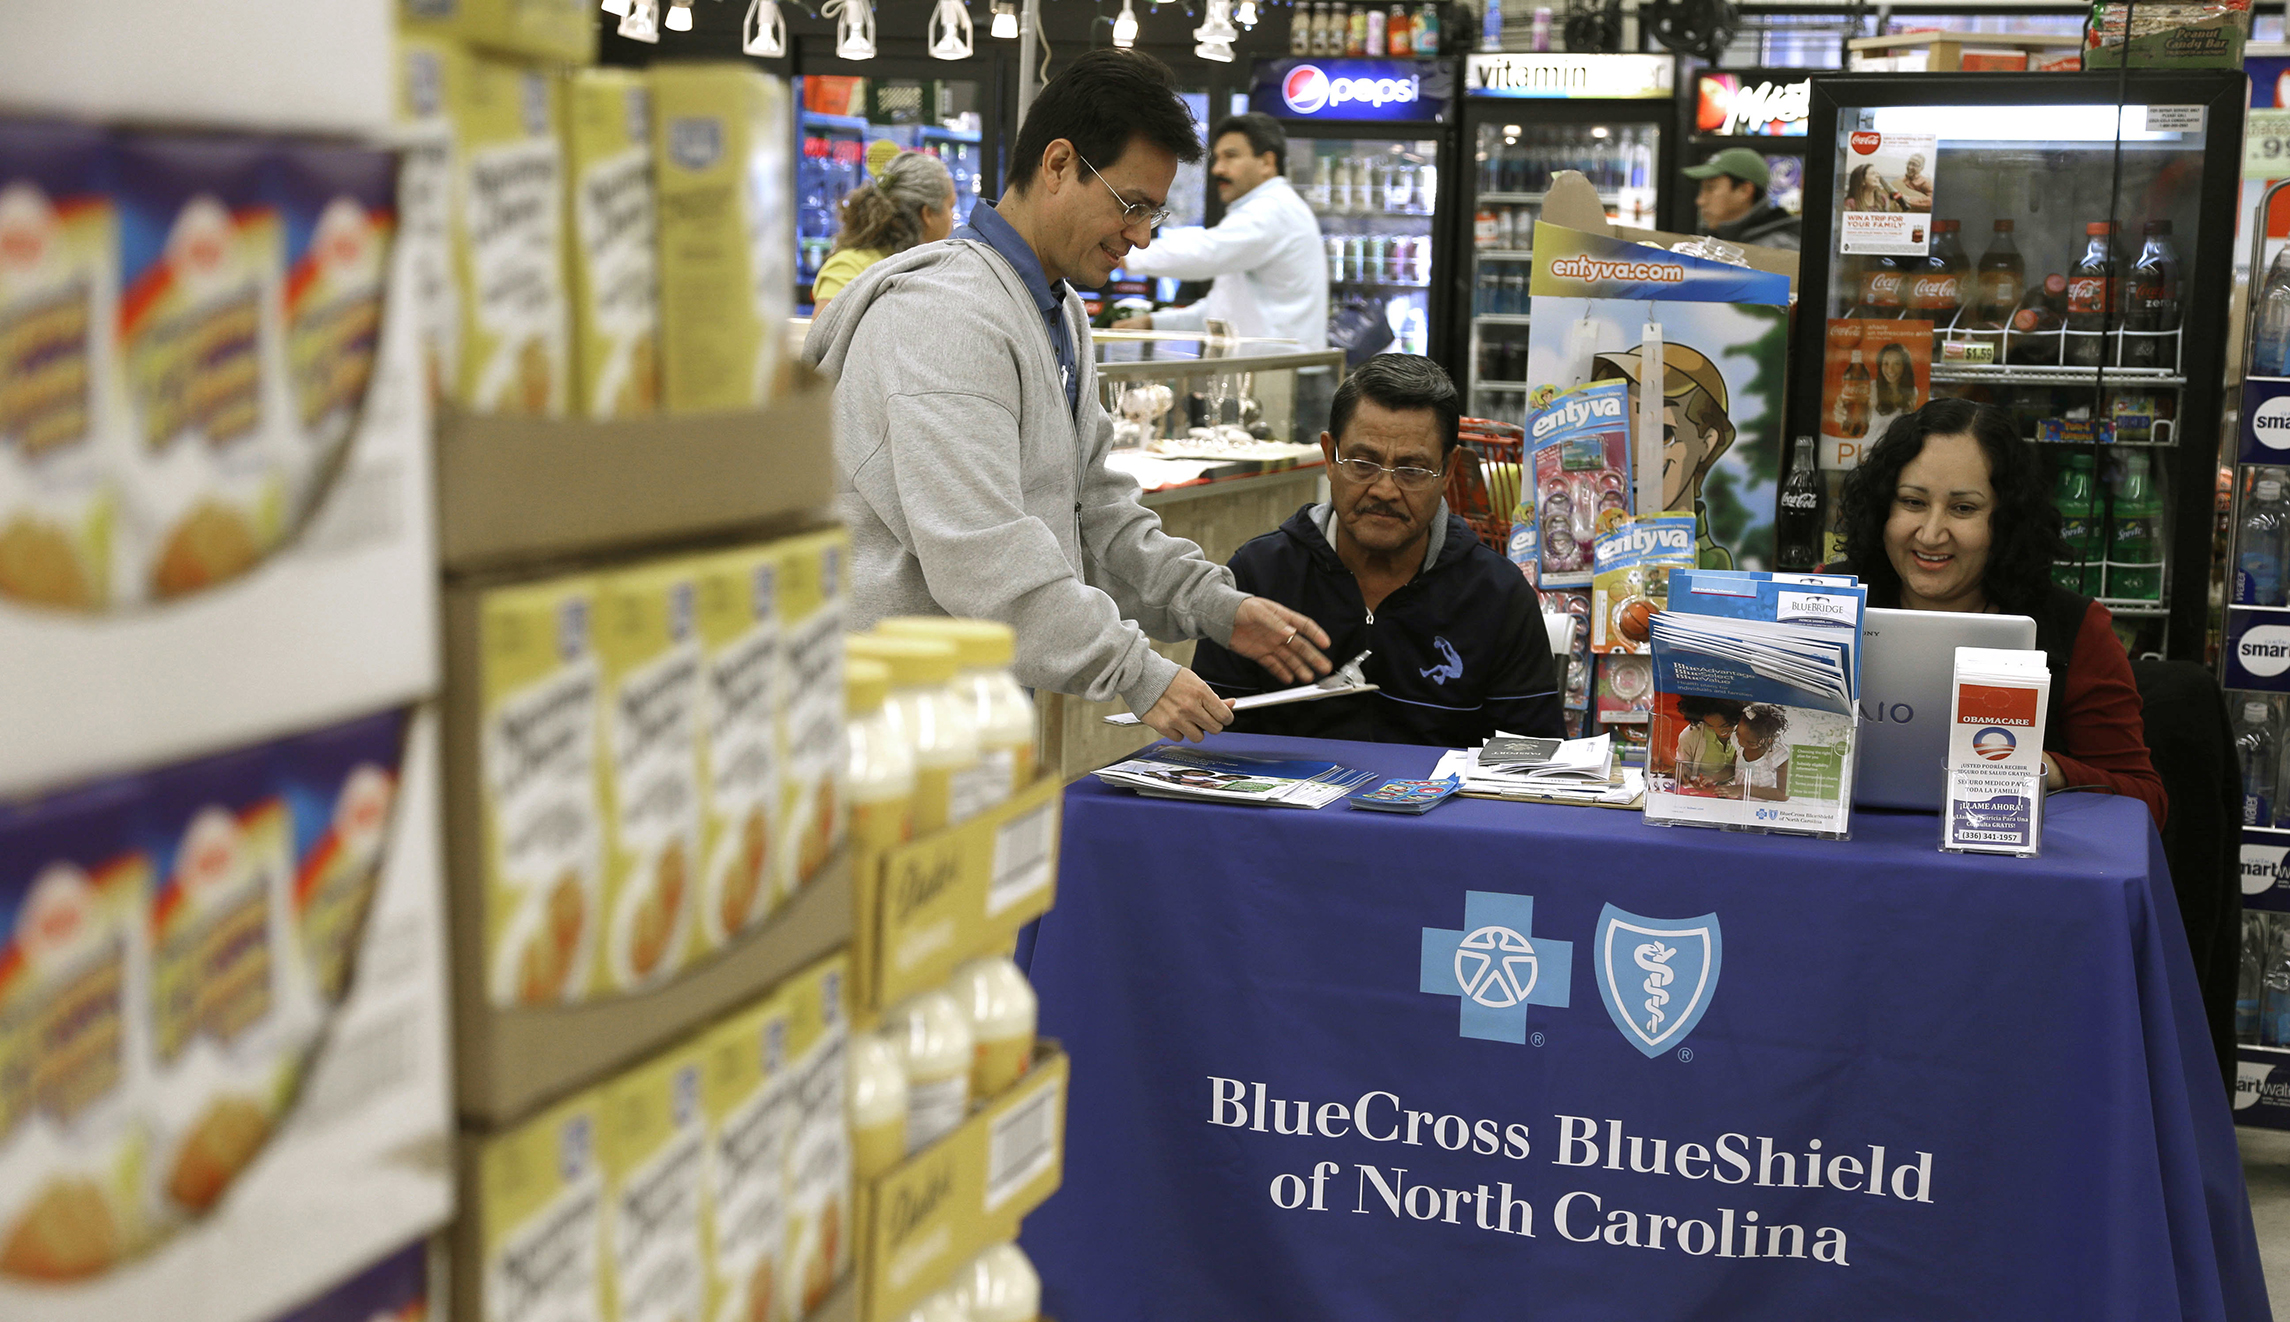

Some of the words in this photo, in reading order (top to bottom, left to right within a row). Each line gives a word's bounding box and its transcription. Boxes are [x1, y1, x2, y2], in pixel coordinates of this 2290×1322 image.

[2176, 28, 2221, 38] Peanut
[2165, 39, 2201, 50] Candy
[2205, 39, 2228, 48] Bar
[1478, 59, 1586, 88] vitamin
[1329, 74, 1420, 108] pepsi
[1552, 254, 1684, 282] entyva.com
[1966, 347, 1993, 361] $1.59
[1532, 398, 1622, 438] entyva
[1596, 528, 1689, 561] entyva
[2241, 643, 2290, 658] smar
[1673, 661, 1756, 679] BlueAdvantage
[1674, 668, 1735, 681] BlueSelect
[1675, 673, 1731, 685] BlueValue
[1859, 701, 1914, 724] IO
[1962, 716, 2030, 726] OBAMACARE
[1991, 802, 2024, 812] AHORA!
[1966, 821, 1991, 829] Coulta
[1962, 831, 1982, 840] (336)
[1983, 832, 2018, 842] 341-1957
[1206, 1075, 1532, 1160] BlueCross
[1552, 1113, 1935, 1204] BlueShield
[1268, 1160, 1340, 1212] of
[1352, 1163, 1537, 1238] North
[1553, 1191, 1851, 1267] Carolina
